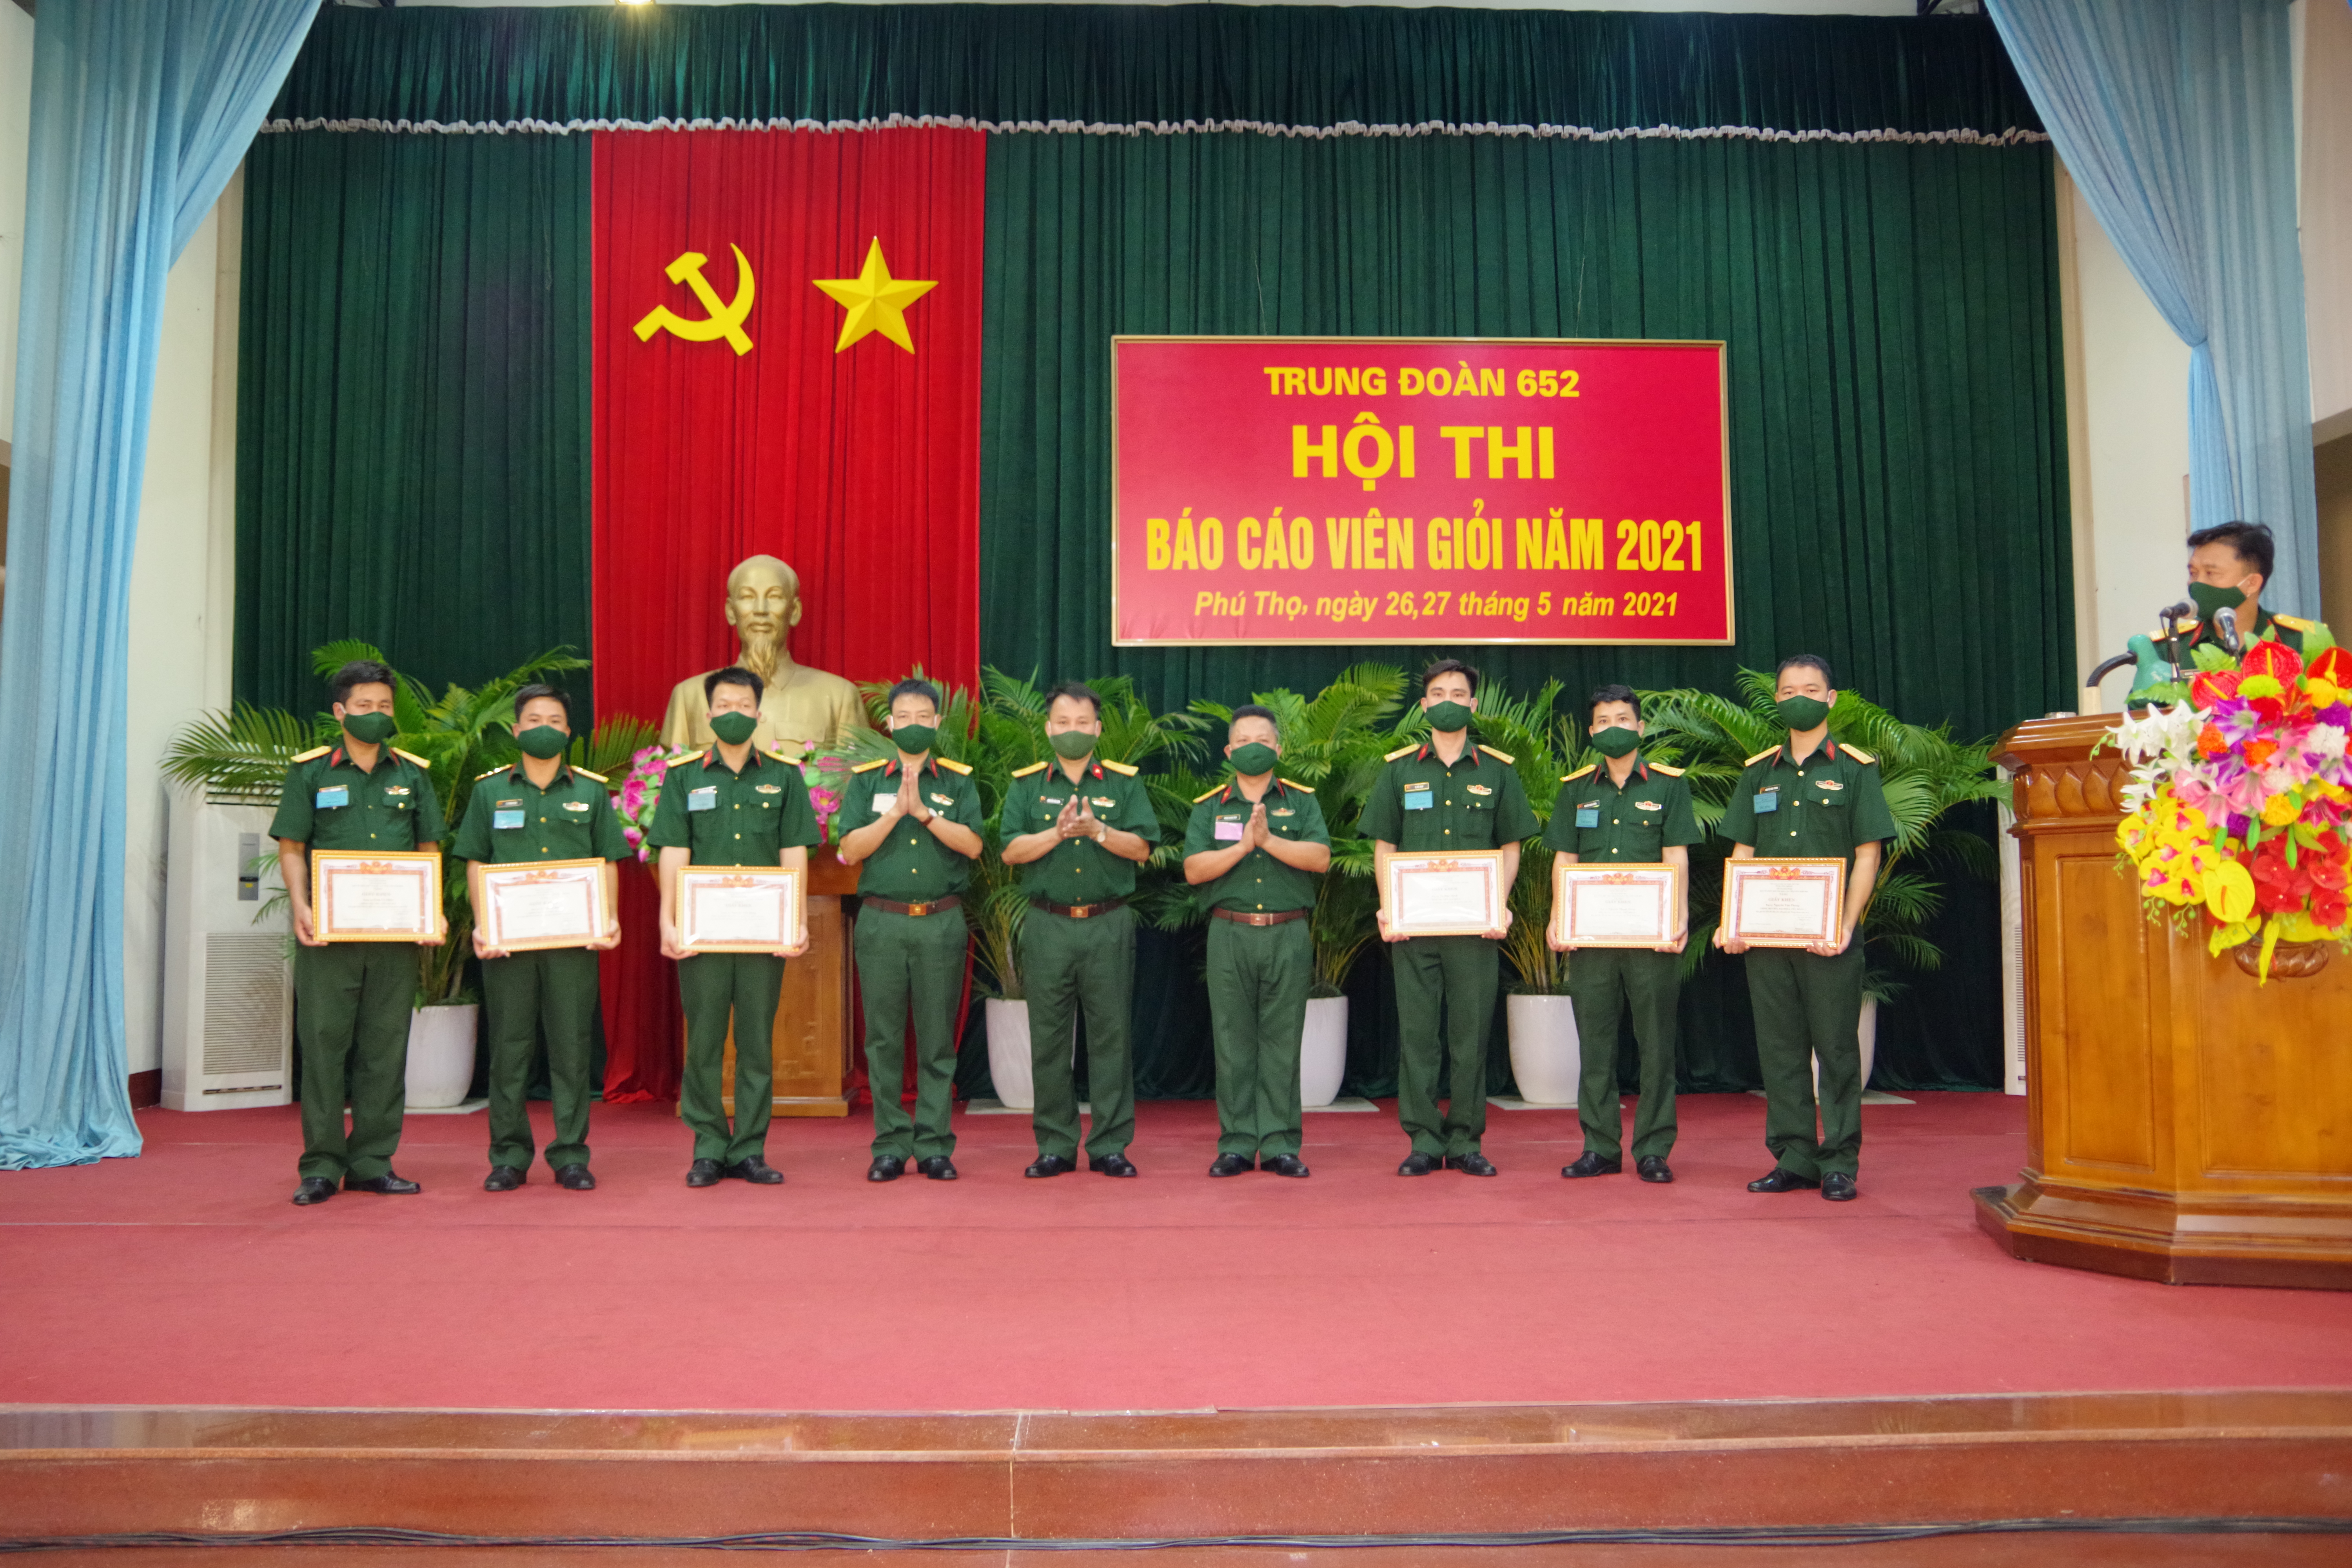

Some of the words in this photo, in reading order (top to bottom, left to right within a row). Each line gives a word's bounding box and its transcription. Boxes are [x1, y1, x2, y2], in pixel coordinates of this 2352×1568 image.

[1264, 367, 1386, 396] TRUNG
[1398, 361, 1505, 396] ĐOÀN
[1517, 369, 1579, 397] 652
[1293, 412, 1415, 491] HỘI
[1440, 426, 1554, 479] THI
[1147, 507, 1223, 570] BÁO
[1237, 507, 1314, 570] CÁO
[1326, 508, 1414, 570] VIÊN
[1428, 499, 1503, 570] GIỎI
[1516, 507, 1603, 570] NĂM
[1617, 520, 1701, 571] 2021
[1195, 591, 1245, 616] Phú
[1254, 591, 1308, 621] Thọ,
[1316, 591, 1378, 622] ngày
[1385, 591, 1452, 620] 26,27
[1459, 590, 1530, 622] tháng
[1537, 592, 1551, 616] 5
[1563, 592, 1614, 616] năm
[1623, 592, 1677, 616] 2021
